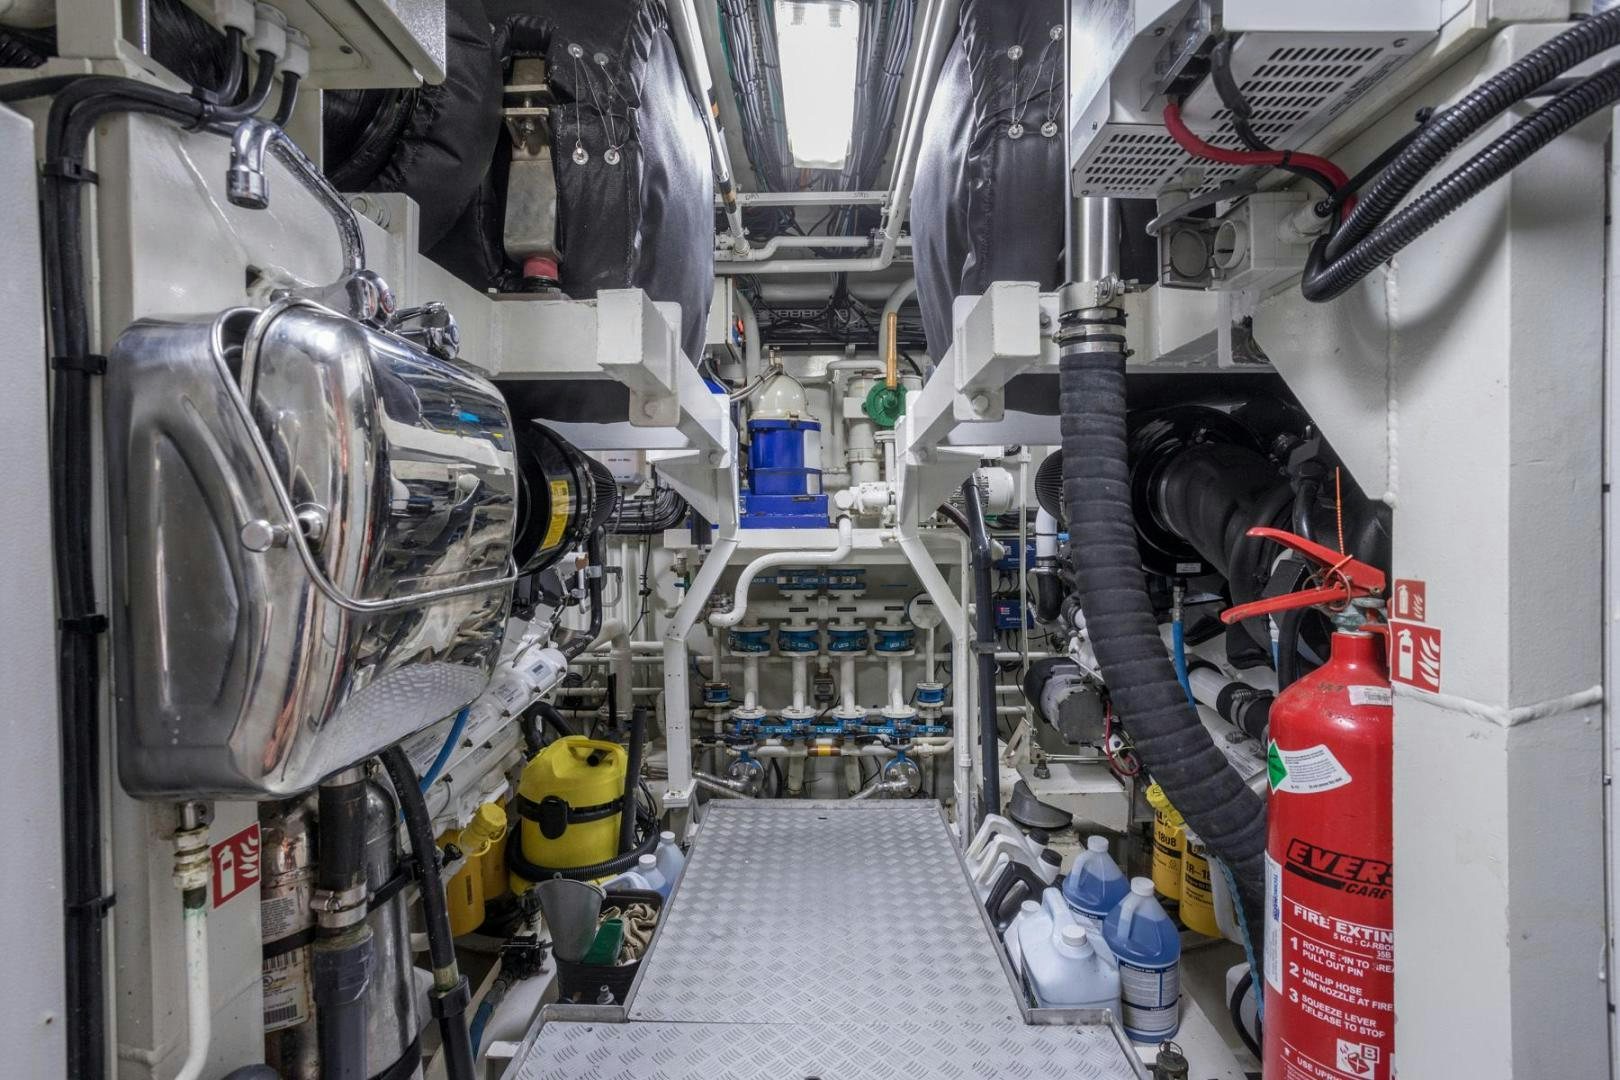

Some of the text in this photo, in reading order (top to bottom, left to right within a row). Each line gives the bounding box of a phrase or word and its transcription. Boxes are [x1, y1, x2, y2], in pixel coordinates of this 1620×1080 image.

[1294, 904, 1330, 929] FIRE
[1290, 936, 1298, 951] 1
[1340, 934, 1353, 944] KG
[1360, 939, 1393, 951] CARBO
[1302, 940, 1336, 960] ROTATE
[1355, 959, 1370, 969] TO
[1302, 949, 1364, 977] PULL OUT PIN
[1289, 961, 1299, 978] 2
[1302, 967, 1363, 996] UNCLIP HOSE
[1288, 987, 1298, 1003] 3
[1302, 976, 1318, 989] AIM
[1319, 985, 1356, 1004] NOZZLE
[1357, 998, 1370, 1007] AT
[1301, 994, 1377, 1028] SQUEEZE LEVER
[1344, 1021, 1358, 1032] TO
[1360, 1026, 1386, 1039] STOP
[1364, 1047, 1377, 1060] B
[1296, 1056, 1313, 1073] USE
